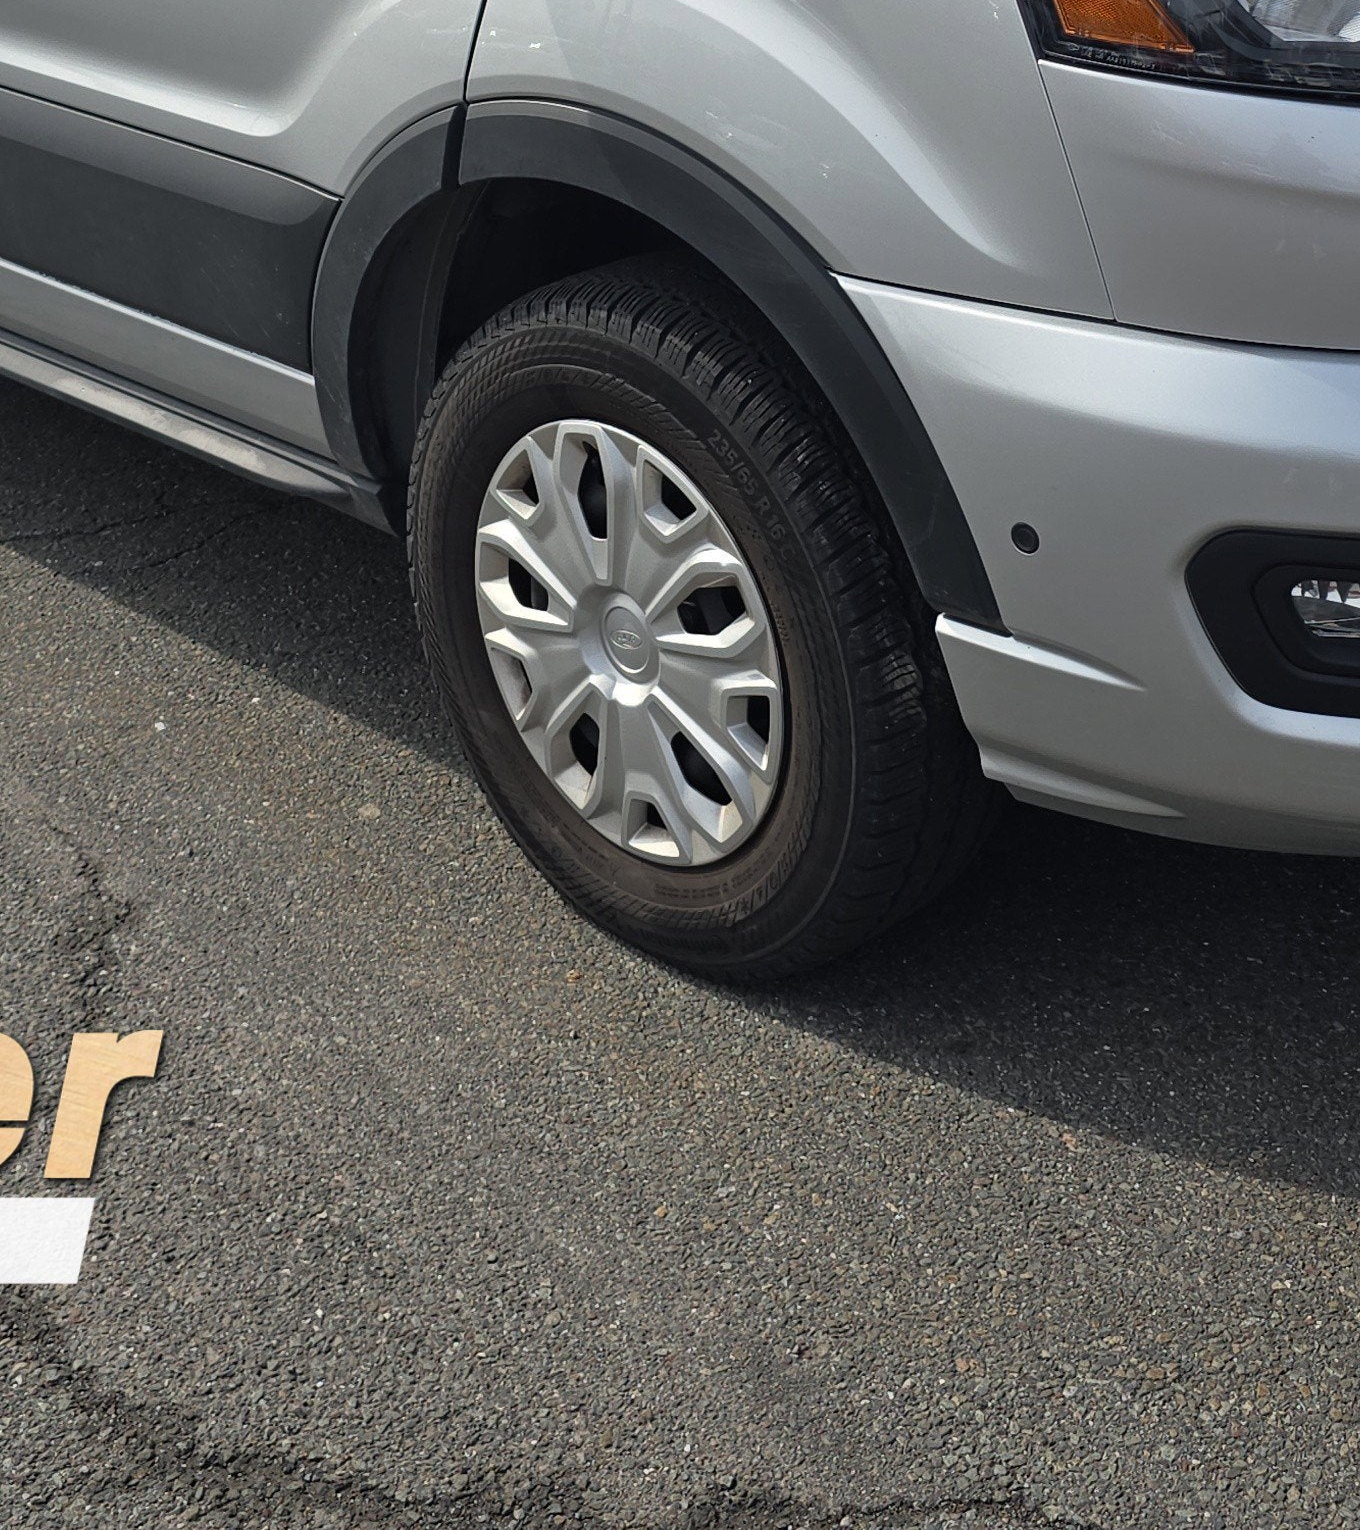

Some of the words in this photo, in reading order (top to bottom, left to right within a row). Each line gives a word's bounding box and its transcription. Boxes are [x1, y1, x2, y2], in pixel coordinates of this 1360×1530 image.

[707, 428, 759, 497] 235/65
[753, 494, 772, 517] R
[766, 517, 787, 542] 16
